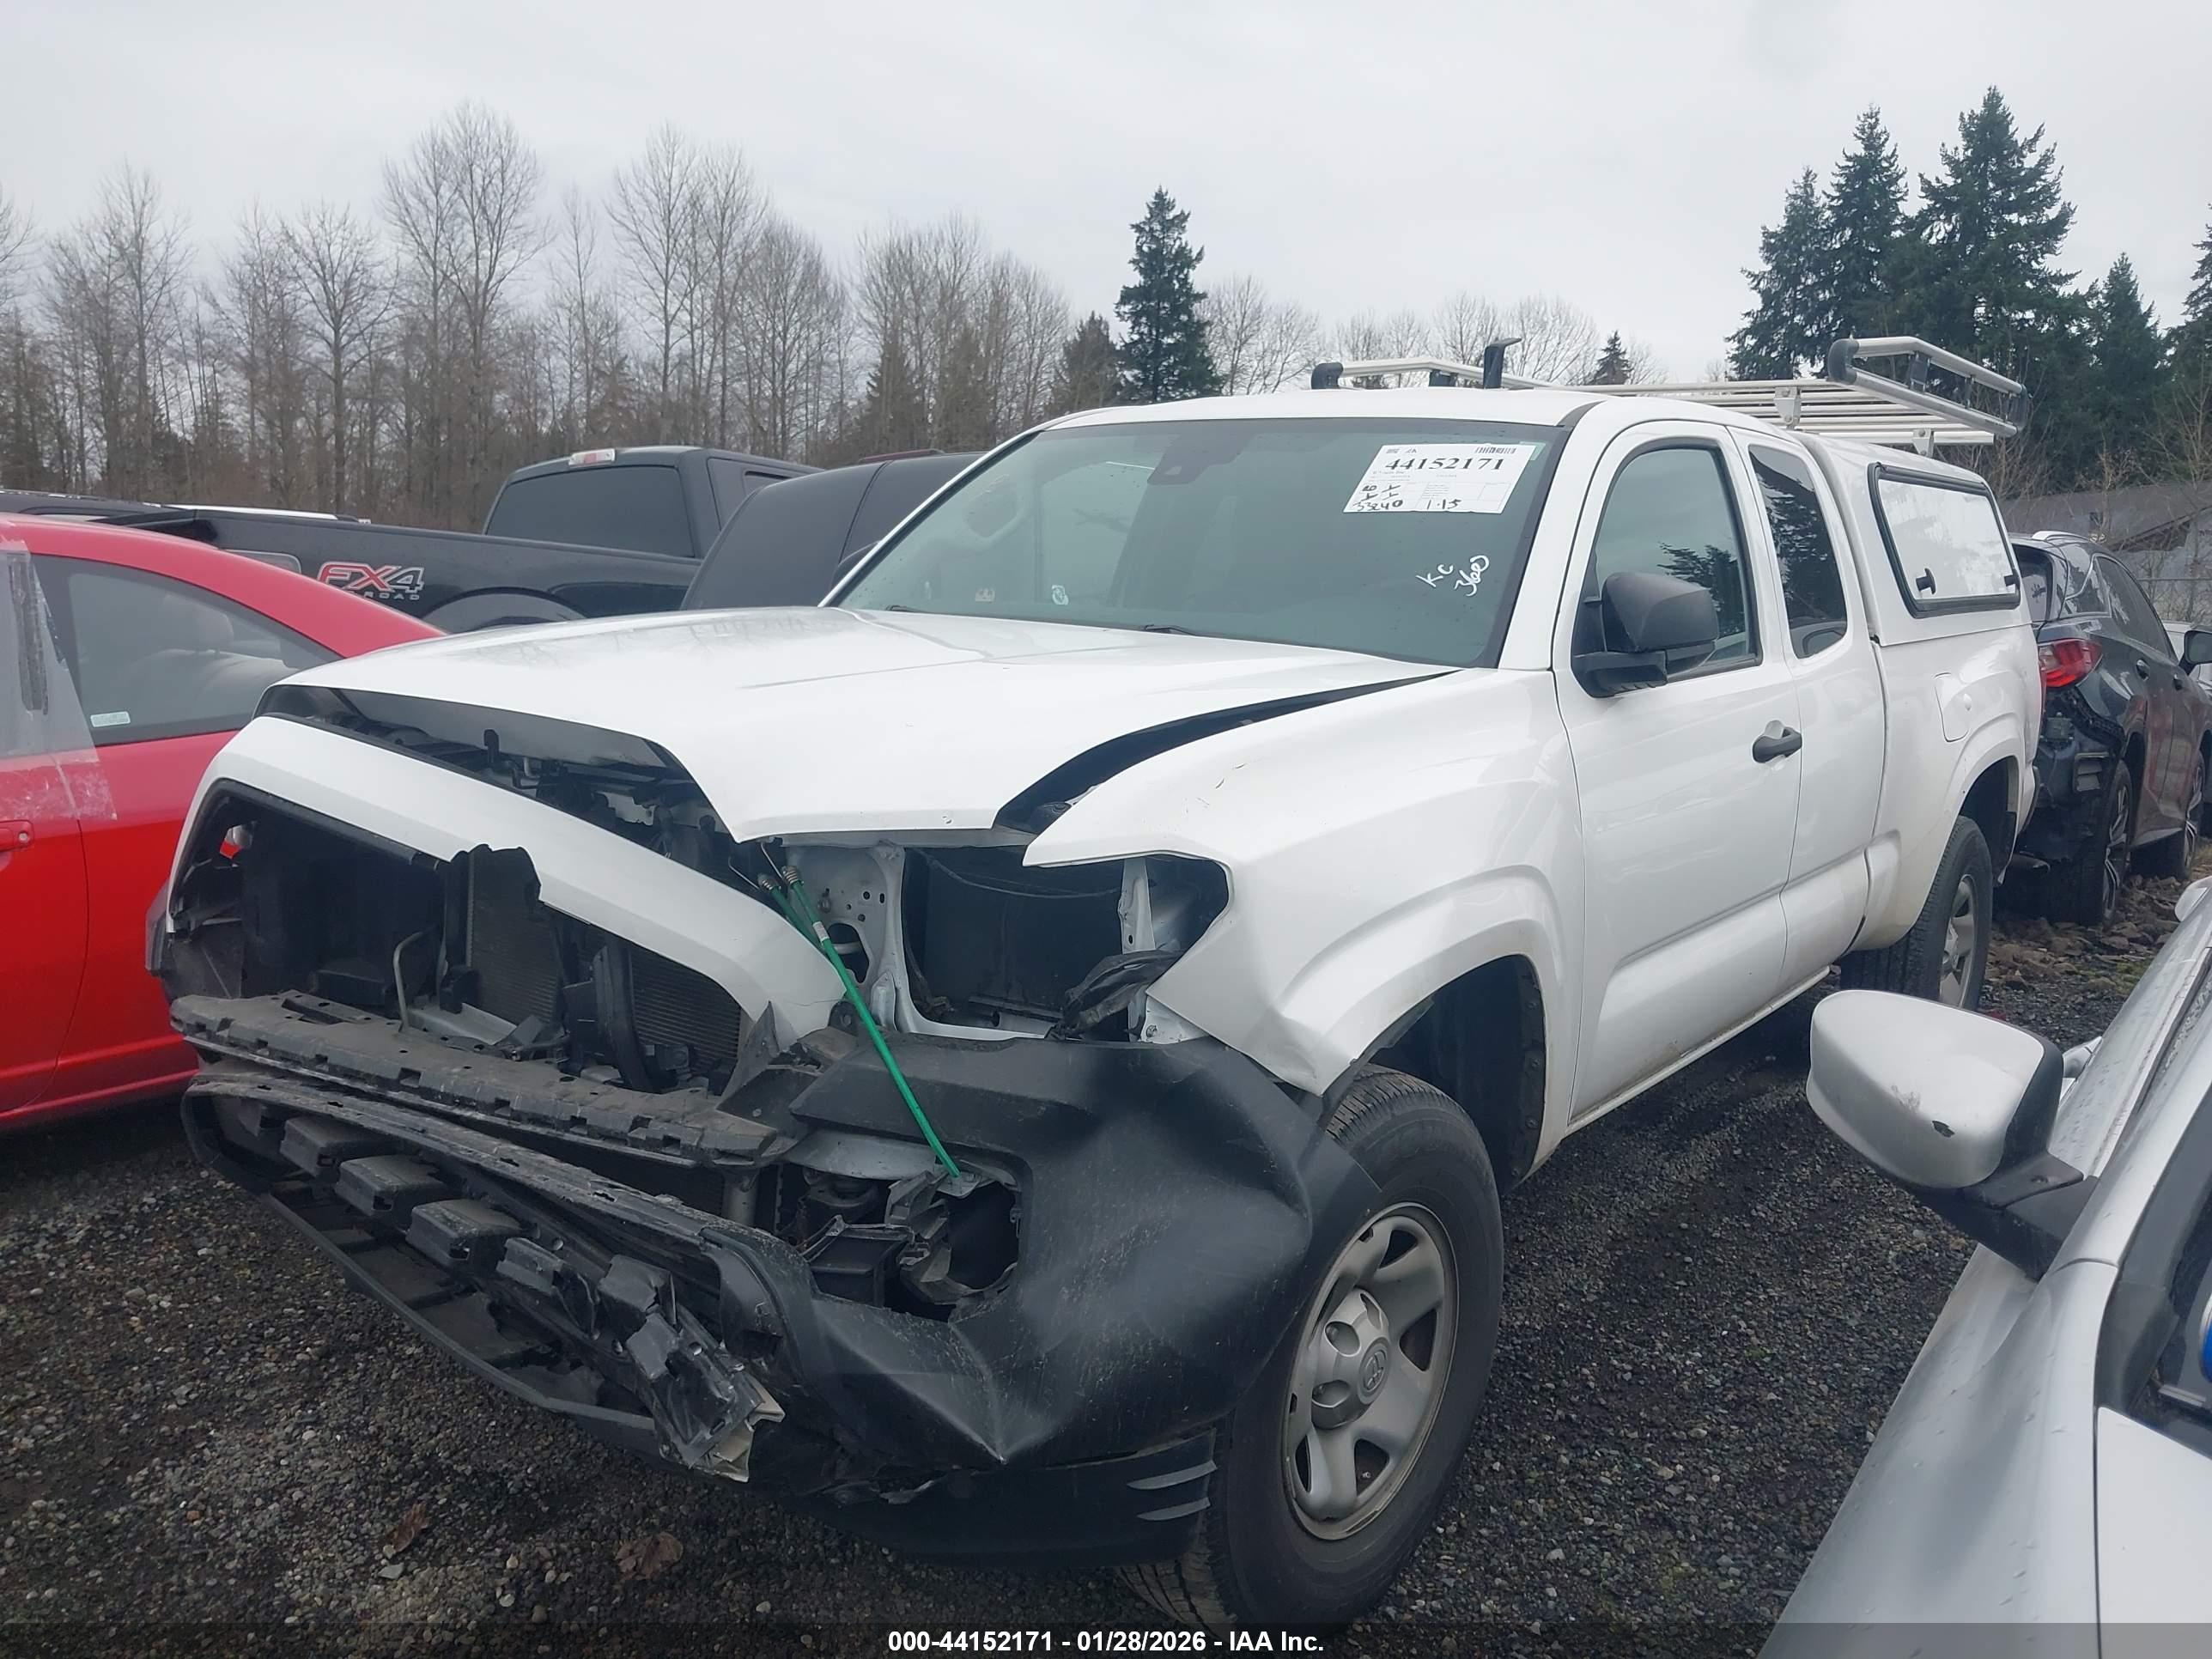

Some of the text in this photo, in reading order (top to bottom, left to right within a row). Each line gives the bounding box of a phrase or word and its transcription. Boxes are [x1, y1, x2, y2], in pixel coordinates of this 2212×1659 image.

[1385, 458, 1504, 470] 44152171
[317, 561, 424, 593] FX4
[364, 591, 420, 600] ROAD
